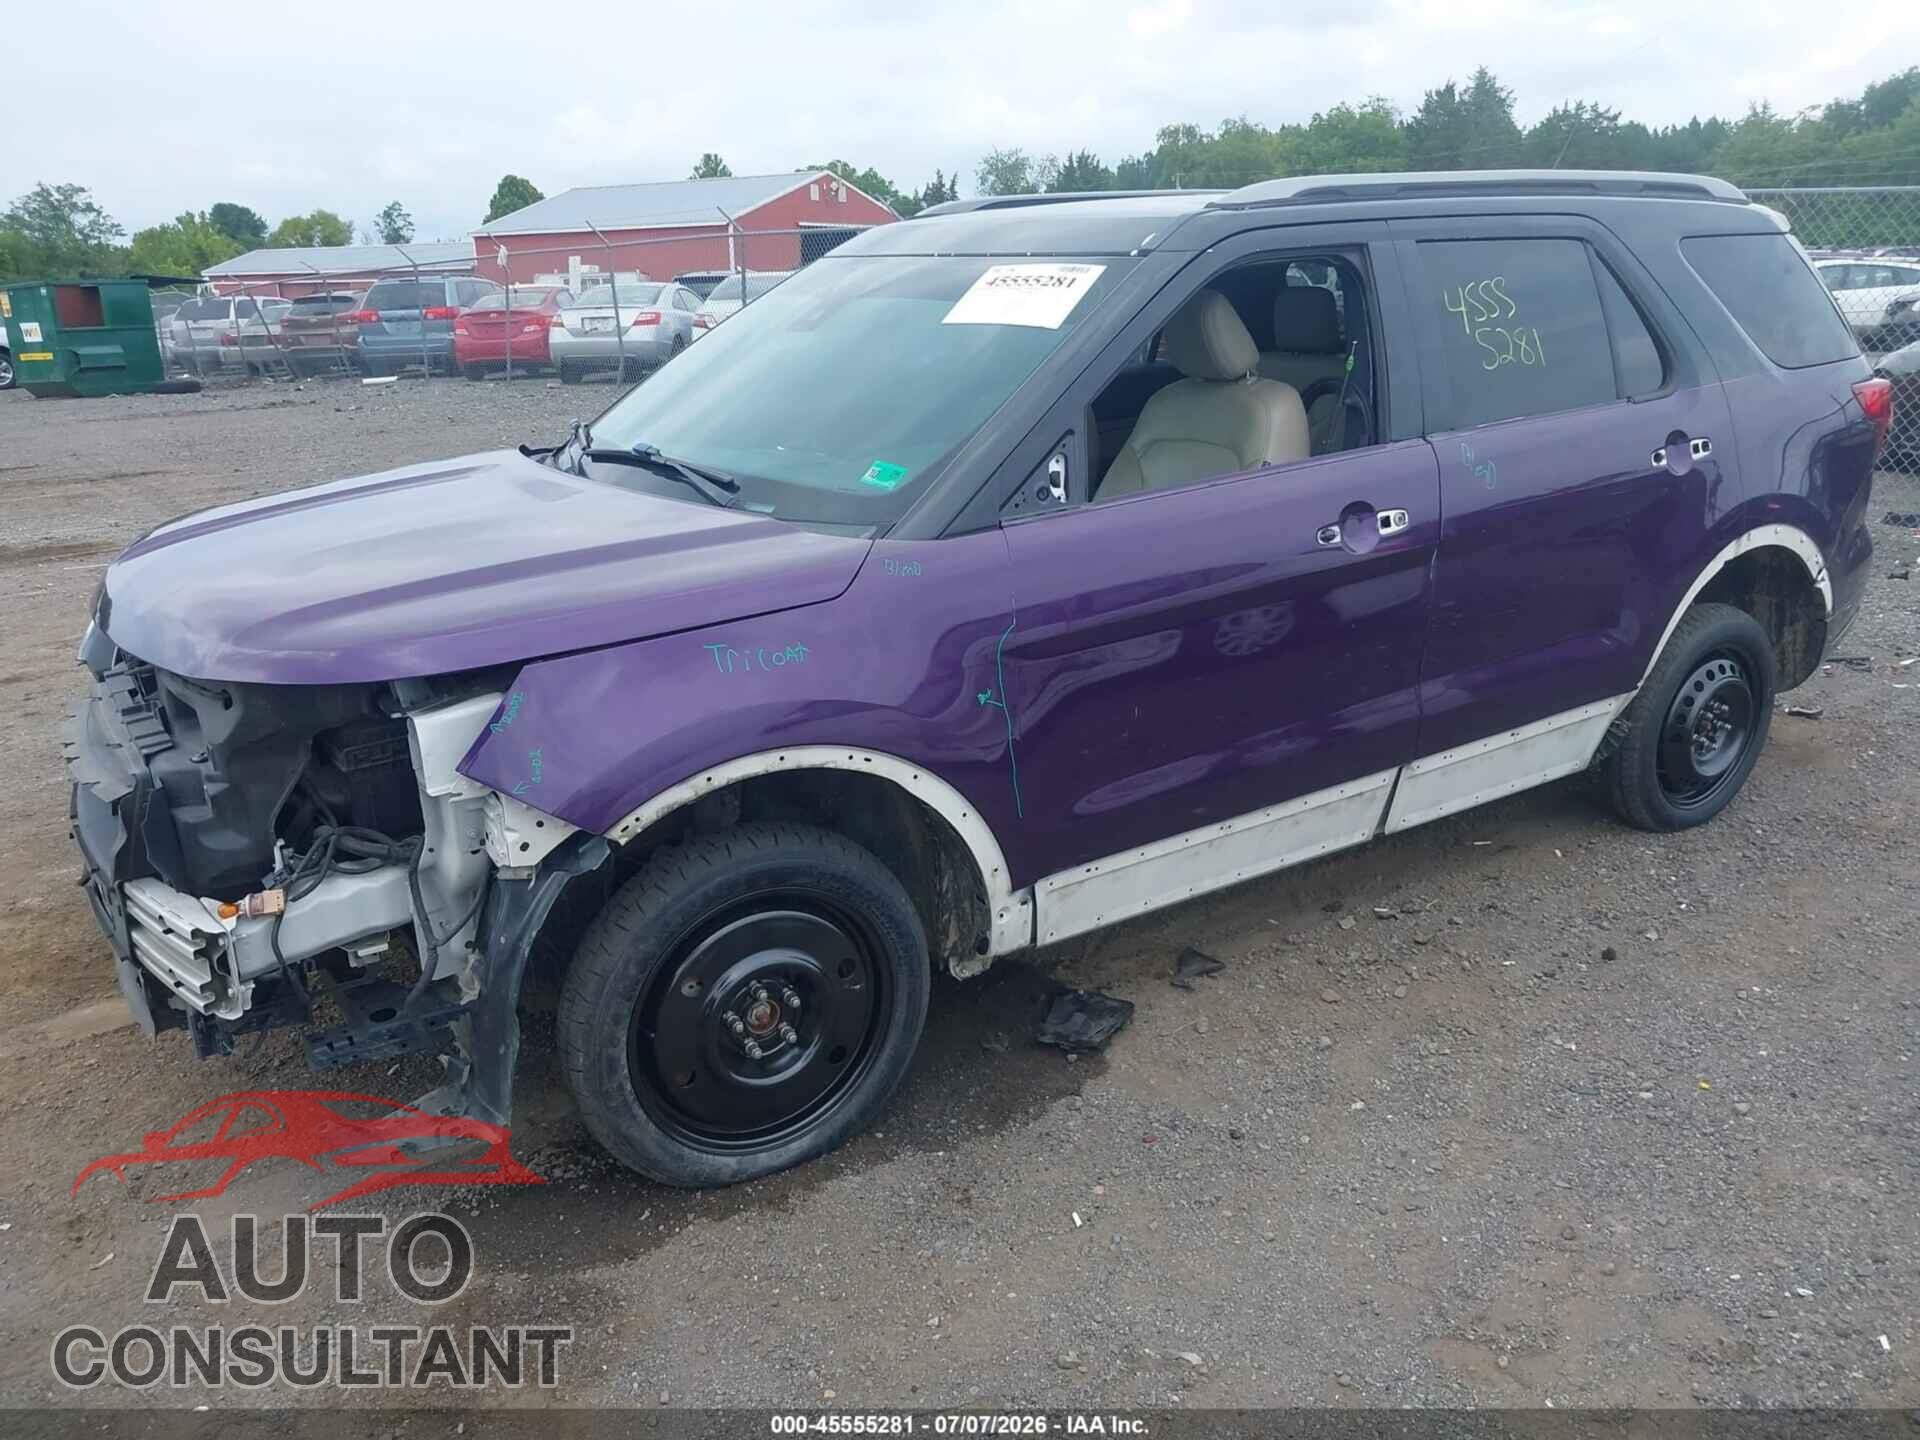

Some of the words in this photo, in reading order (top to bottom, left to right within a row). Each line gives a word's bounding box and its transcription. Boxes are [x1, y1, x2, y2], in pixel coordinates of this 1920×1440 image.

[985, 275, 1078, 289] 45555281
[1443, 276, 1516, 335] 4555
[1475, 327, 1546, 370] 5281
